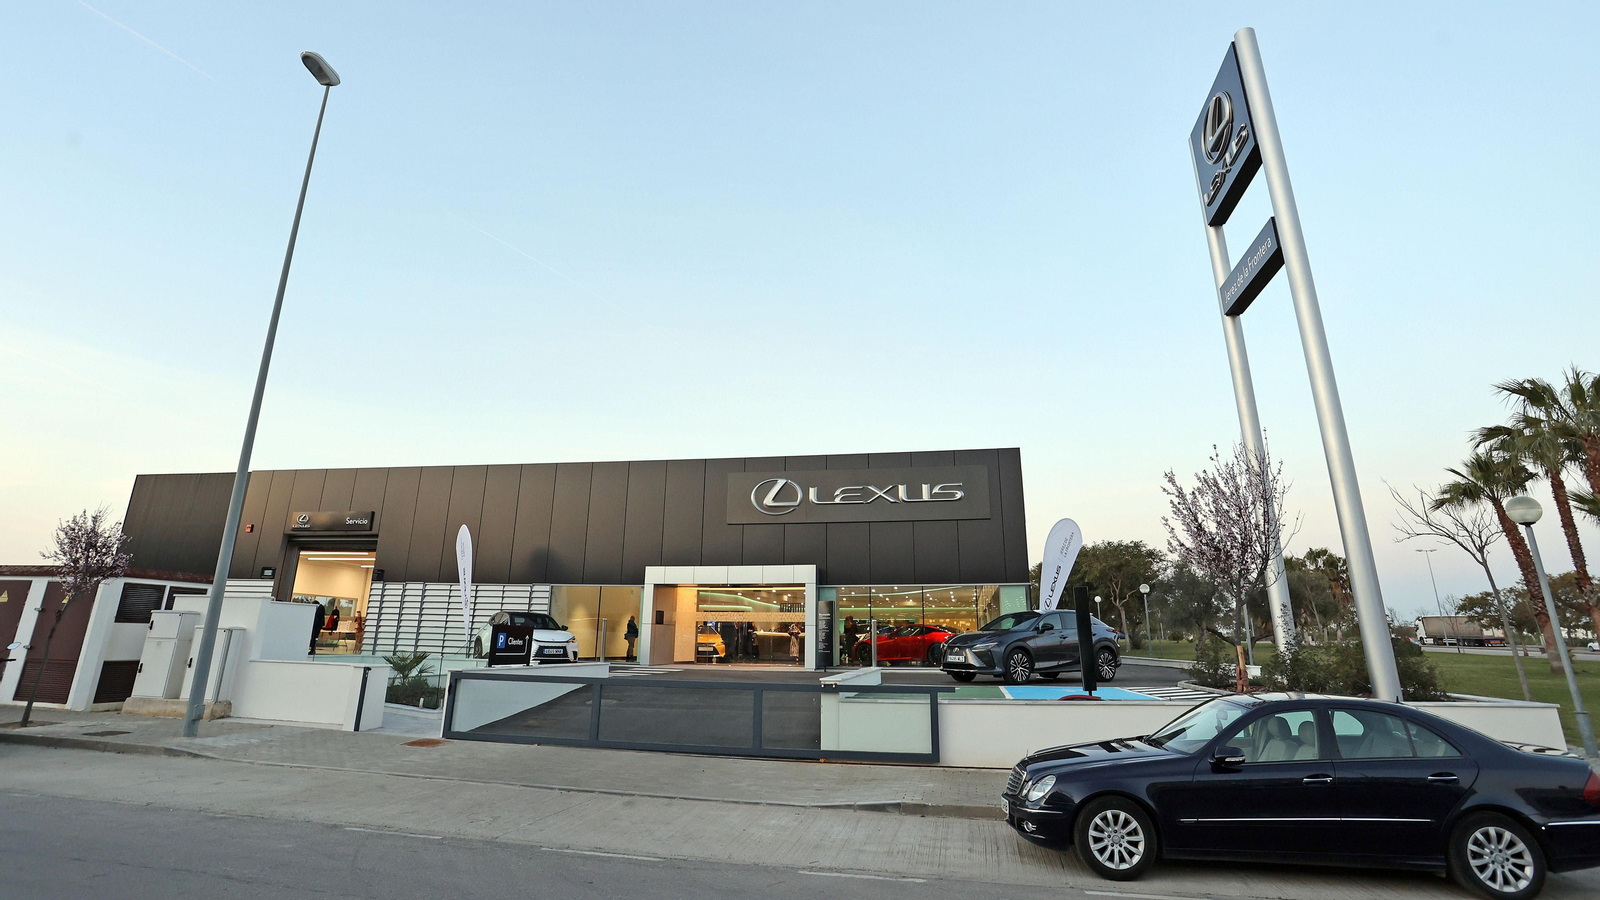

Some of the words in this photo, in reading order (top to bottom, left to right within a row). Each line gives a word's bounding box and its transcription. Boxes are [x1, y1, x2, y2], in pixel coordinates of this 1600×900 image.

[1204, 123, 1249, 207] LEXUS
[1225, 283, 1238, 304] Jerez
[1236, 272, 1244, 287] de
[1242, 266, 1249, 279] la
[1247, 237, 1272, 272] Frontera
[809, 482, 964, 504] LEXUS
[345, 516, 368, 525] Servicio
[1048, 565, 1062, 598] LEXUS
[498, 634, 505, 647] P
[508, 637, 524, 646] Clientes
